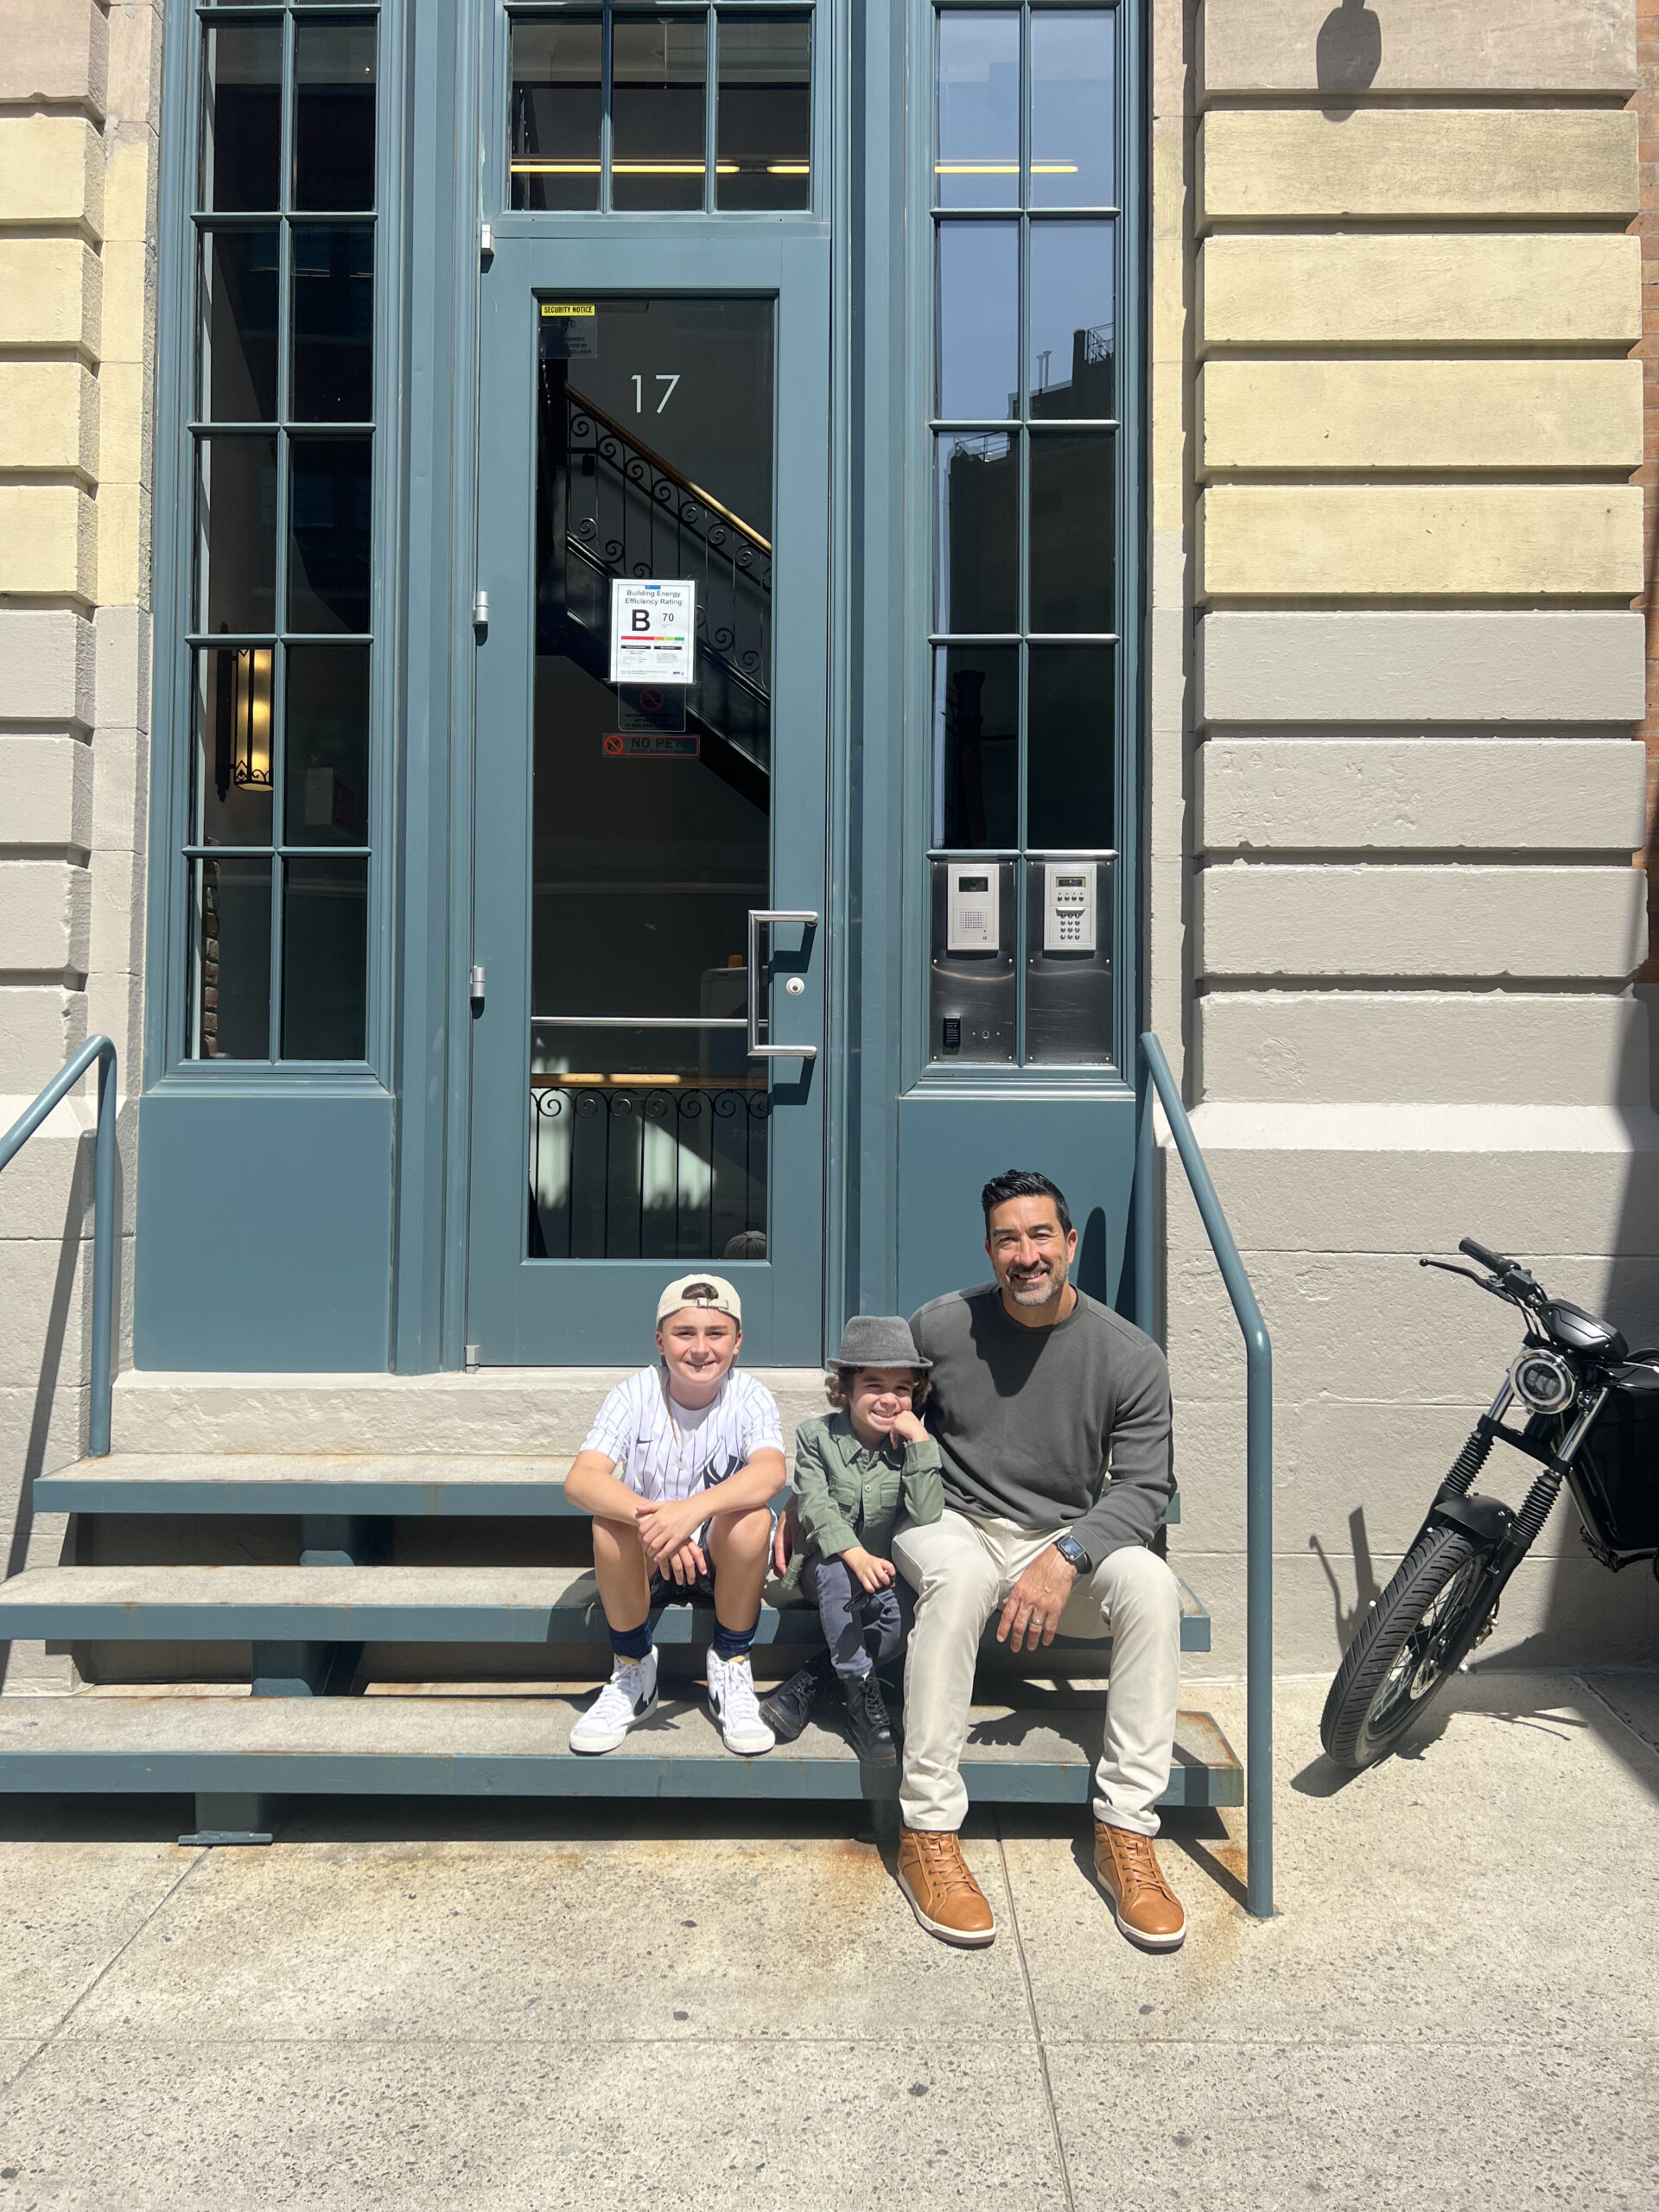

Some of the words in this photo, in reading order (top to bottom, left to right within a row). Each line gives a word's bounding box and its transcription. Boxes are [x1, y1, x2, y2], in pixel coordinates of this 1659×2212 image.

[631, 374, 681, 413] 17
[626, 589, 655, 598] Building
[632, 609, 651, 632] B
[662, 613, 674, 622] 70
[631, 738, 650, 748] NO
